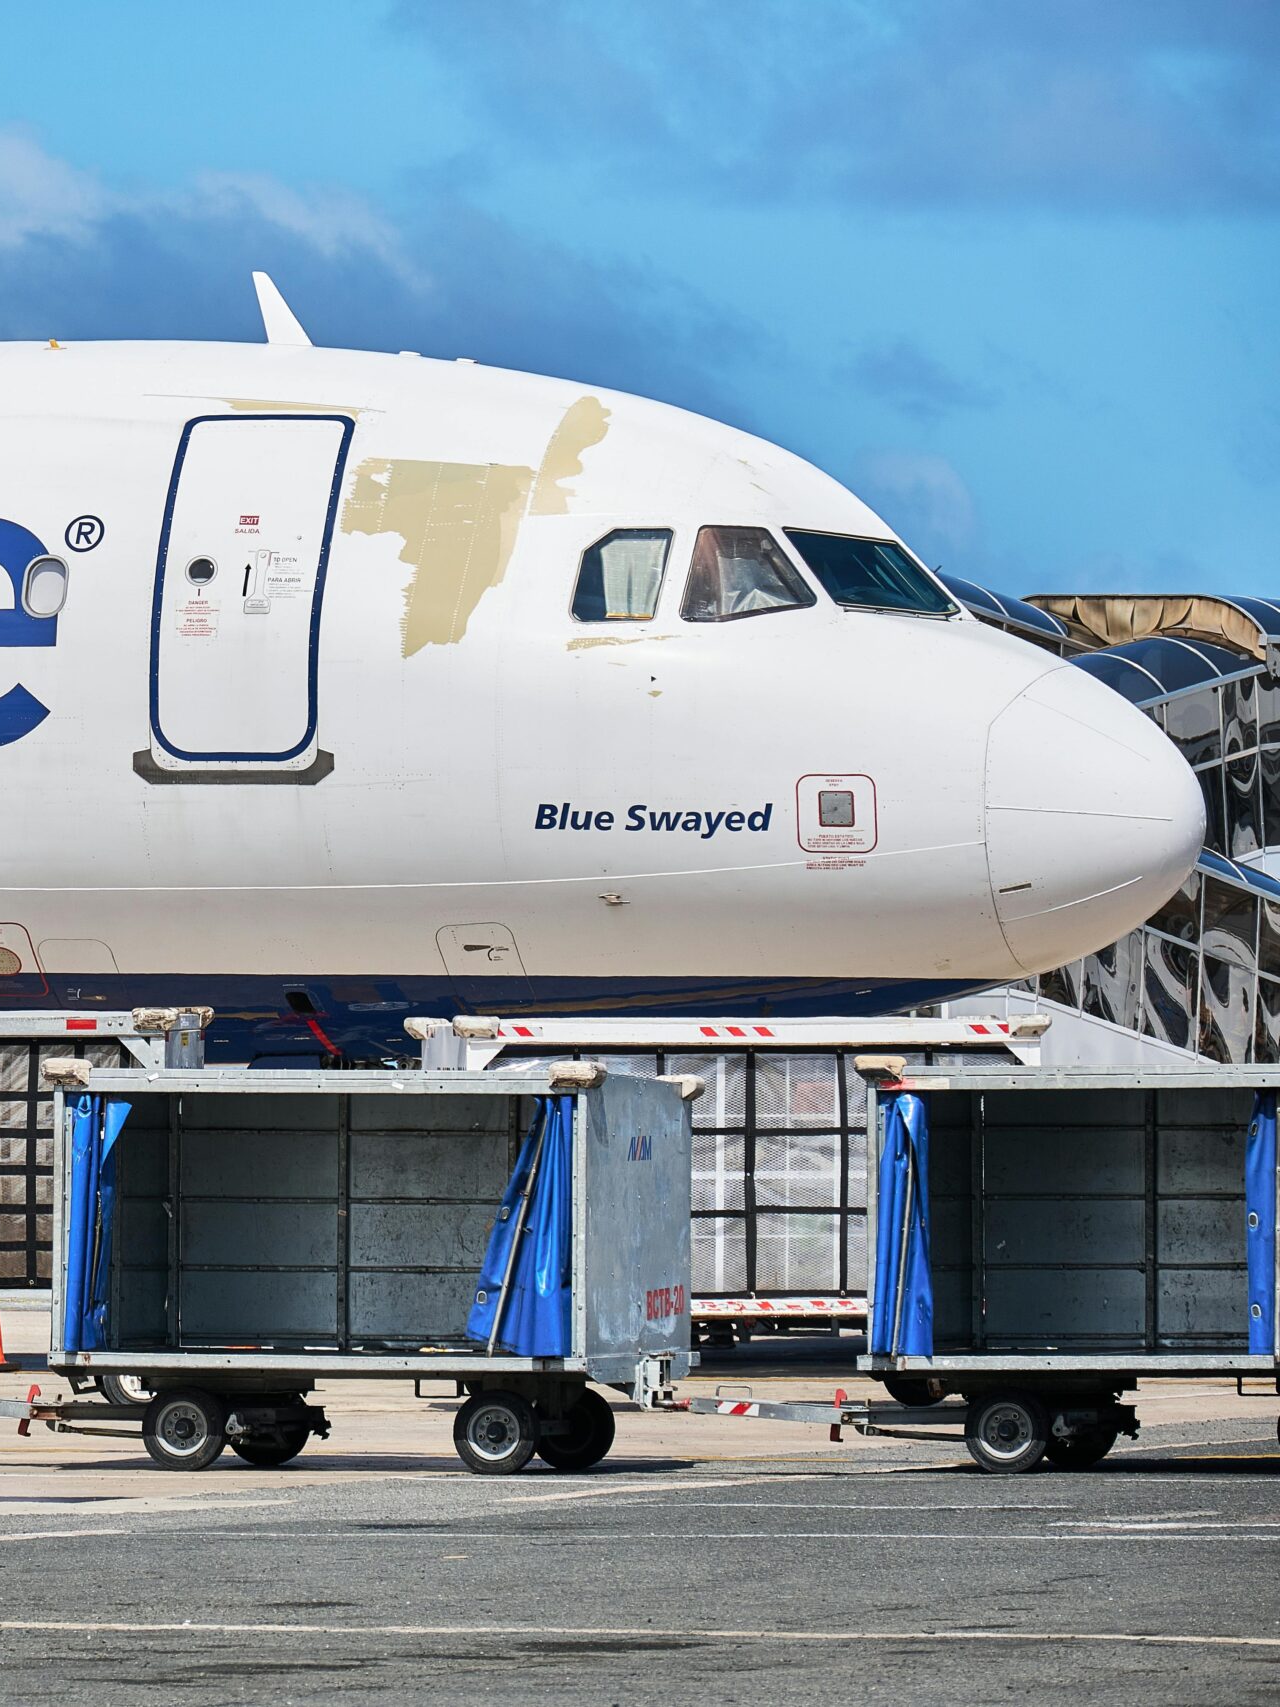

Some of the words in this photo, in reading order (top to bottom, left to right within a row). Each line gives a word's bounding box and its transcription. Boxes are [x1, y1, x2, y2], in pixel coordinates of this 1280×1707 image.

[240, 516, 259, 524] EXIT
[534, 802, 615, 831] Blue
[625, 803, 773, 839] Swayed
[646, 1284, 684, 1321] BCTB-20
